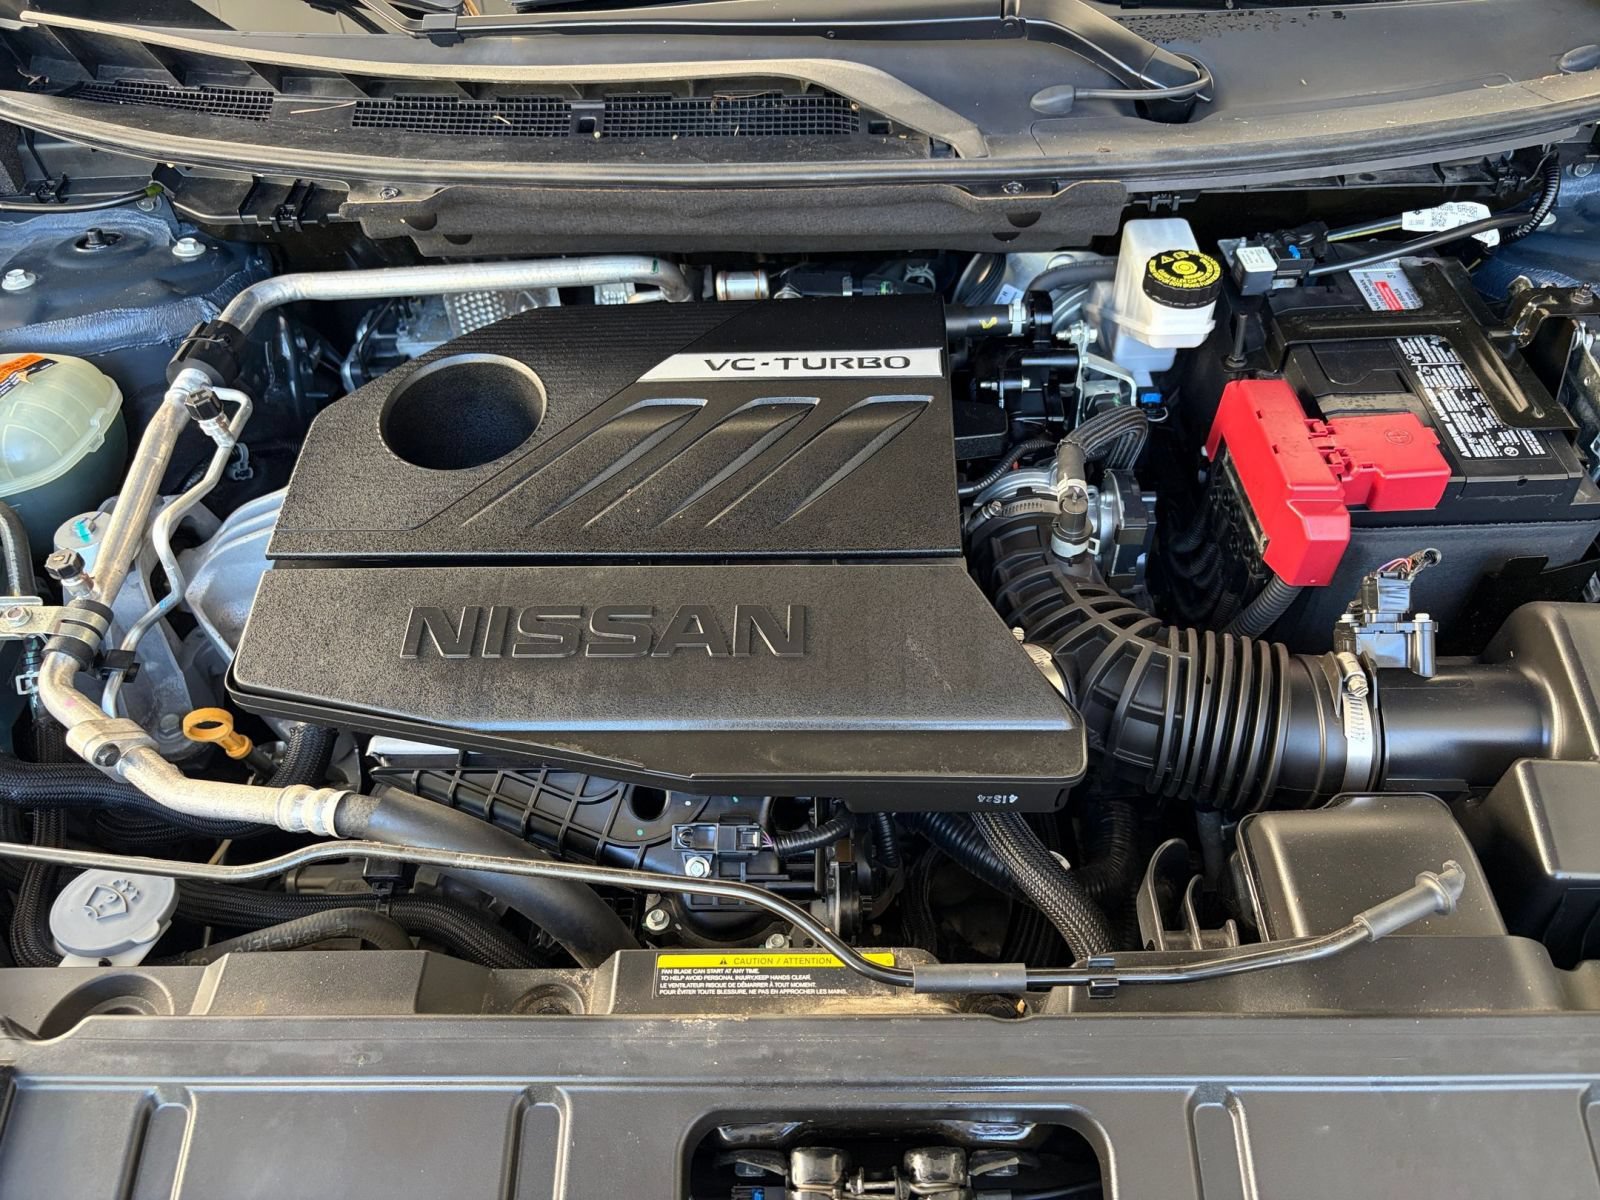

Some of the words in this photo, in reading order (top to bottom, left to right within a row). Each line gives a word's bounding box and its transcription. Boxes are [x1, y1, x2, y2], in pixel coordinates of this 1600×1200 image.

[400, 604, 806, 659] NISSAN
[733, 957, 773, 965] CAUTION
[783, 957, 832, 965] ATTENTION
